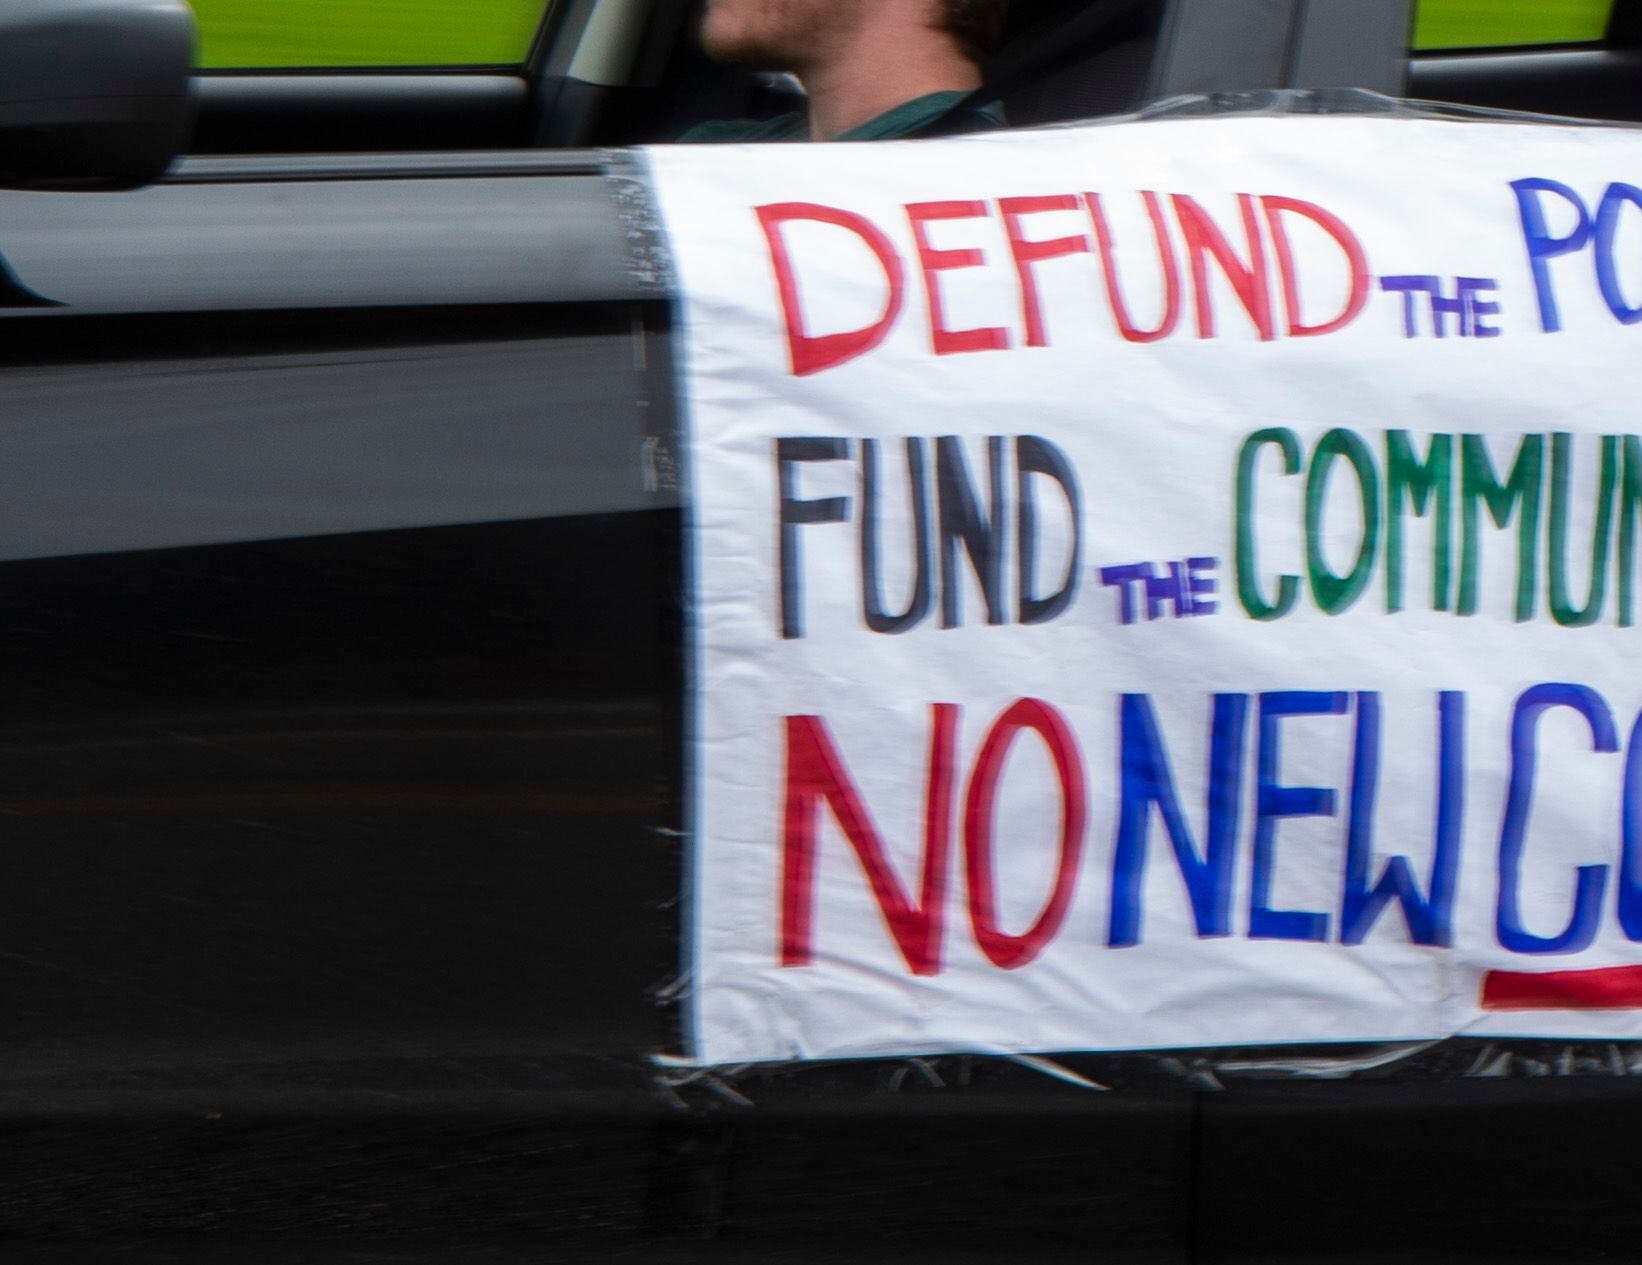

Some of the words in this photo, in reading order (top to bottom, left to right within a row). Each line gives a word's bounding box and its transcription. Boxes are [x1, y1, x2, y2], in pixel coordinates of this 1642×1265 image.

[755, 189, 1369, 377] DEFUND
[1381, 274, 1504, 340] THE
[774, 433, 1081, 641] FUND
[1099, 554, 1219, 626] THE
[778, 696, 1089, 978] NO
[1106, 689, 1465, 951] NEW
